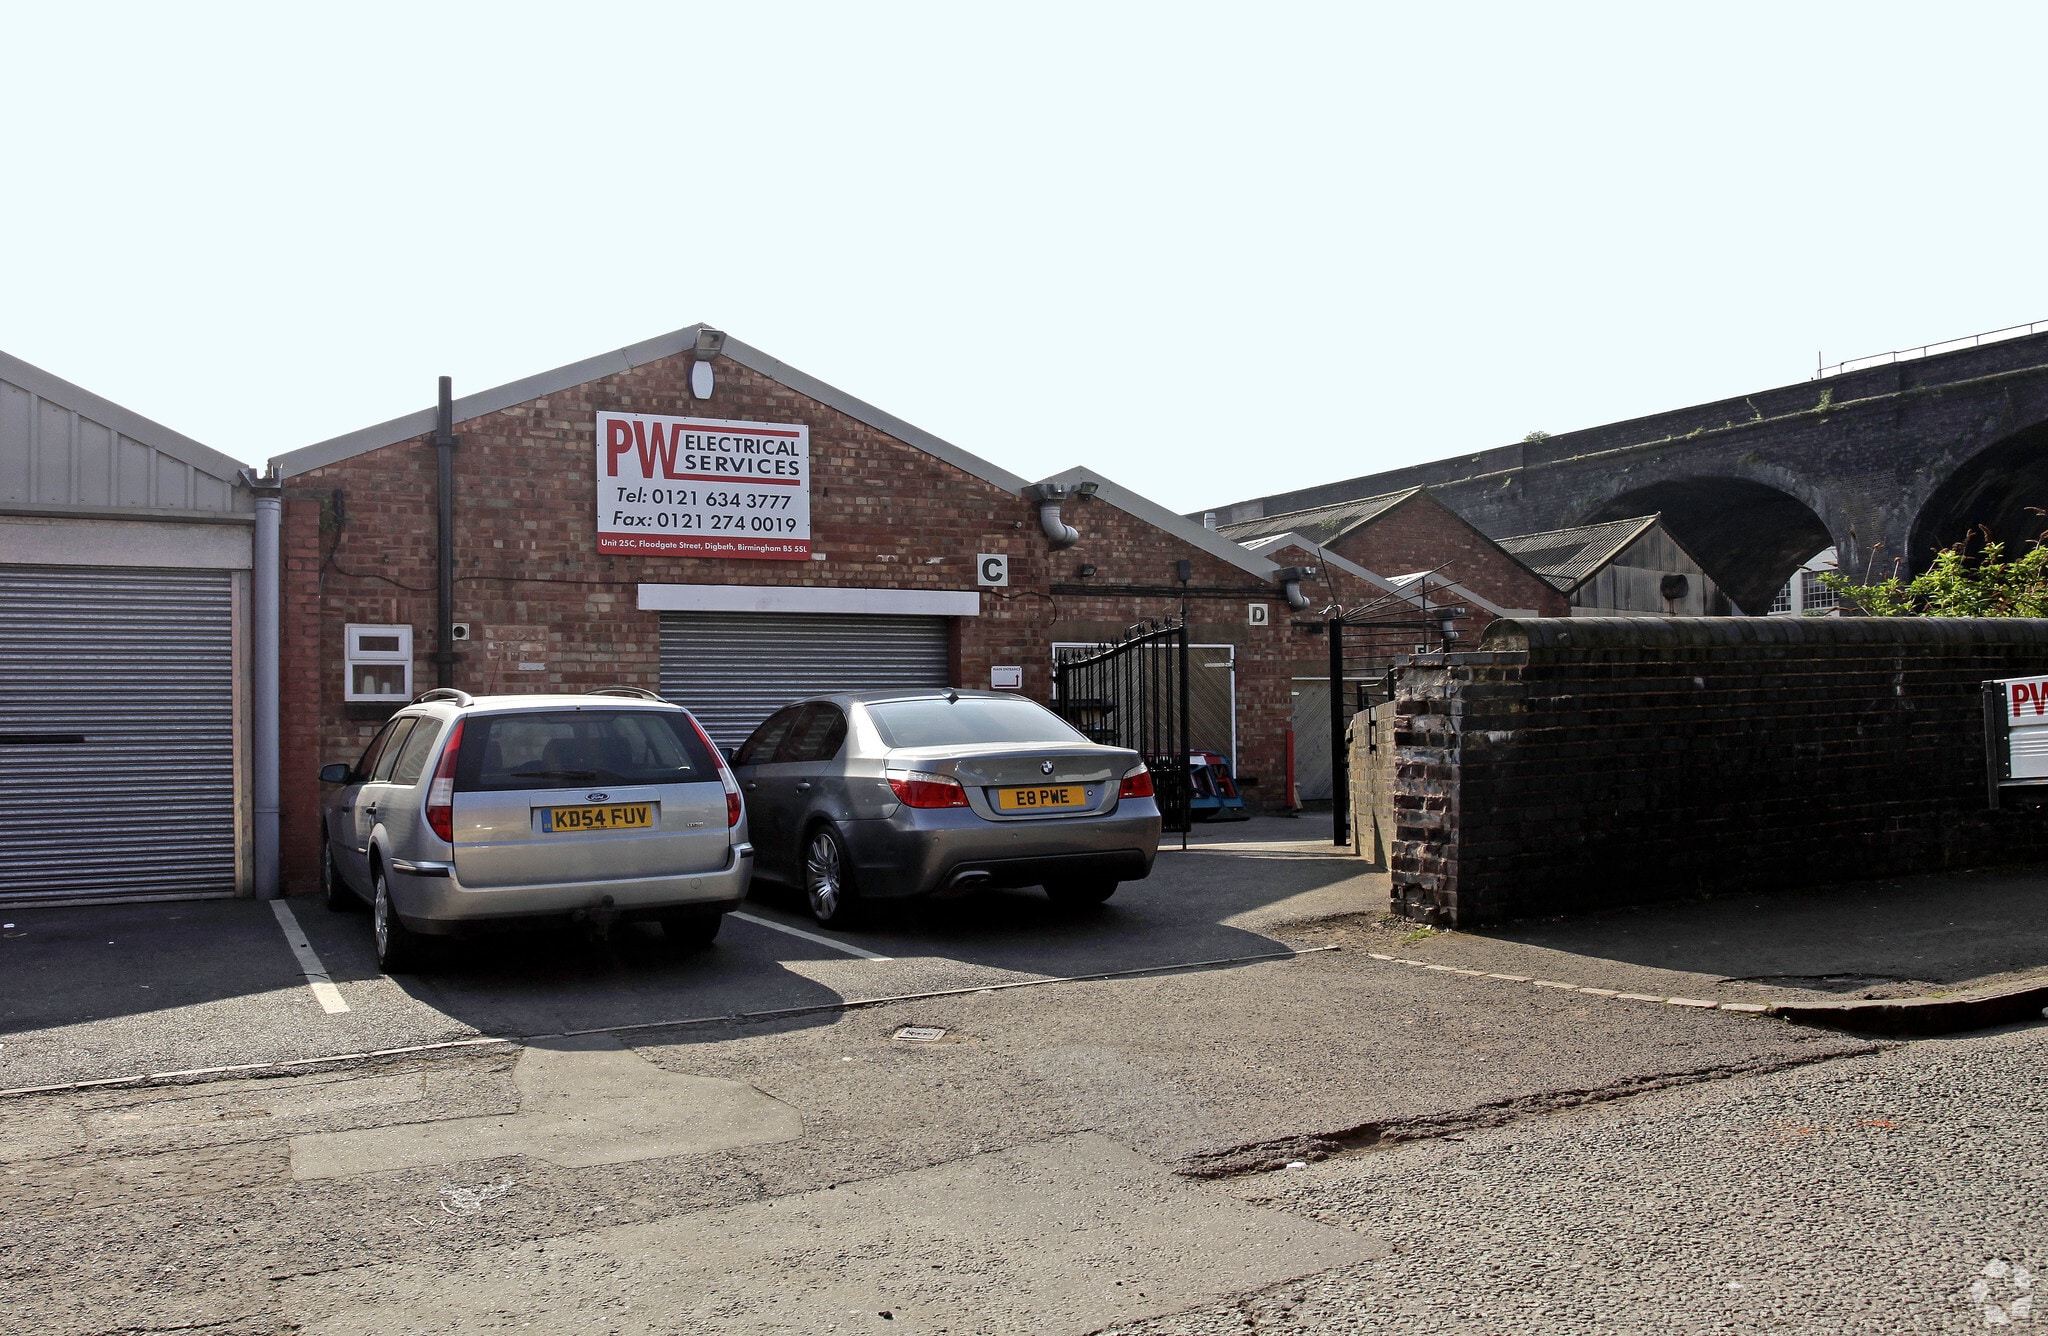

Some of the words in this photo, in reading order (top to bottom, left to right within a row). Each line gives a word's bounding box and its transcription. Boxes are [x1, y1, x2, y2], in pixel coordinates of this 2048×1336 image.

[606, 419, 681, 479] PW
[684, 434, 800, 457] ELECTRICAL
[684, 454, 800, 476] SERVICES
[616, 486, 648, 504] Tel:
[651, 488, 697, 506] 0121
[705, 491, 741, 508] 634
[746, 493, 792, 510] 3777
[612, 510, 653, 527] Fax:
[657, 512, 702, 529] 0121
[710, 515, 746, 531] 274
[751, 516, 797, 533] 0019
[601, 538, 617, 547] Unit
[619, 539, 637, 548] 25C,
[639, 540, 677, 550] Floodgate
[679, 541, 703, 551] Street,
[704, 542, 736, 552] Digbeth,
[737, 543, 781, 554] Birmingham
[782, 544, 793, 553] B5
[794, 545, 808, 553] 5SL
[981, 558, 1004, 582] C
[1252, 606, 1265, 623] D
[1016, 790, 1037, 806] E8
[1040, 789, 1070, 805] PWE
[555, 809, 606, 827] KD54
[610, 807, 647, 825] FUV
